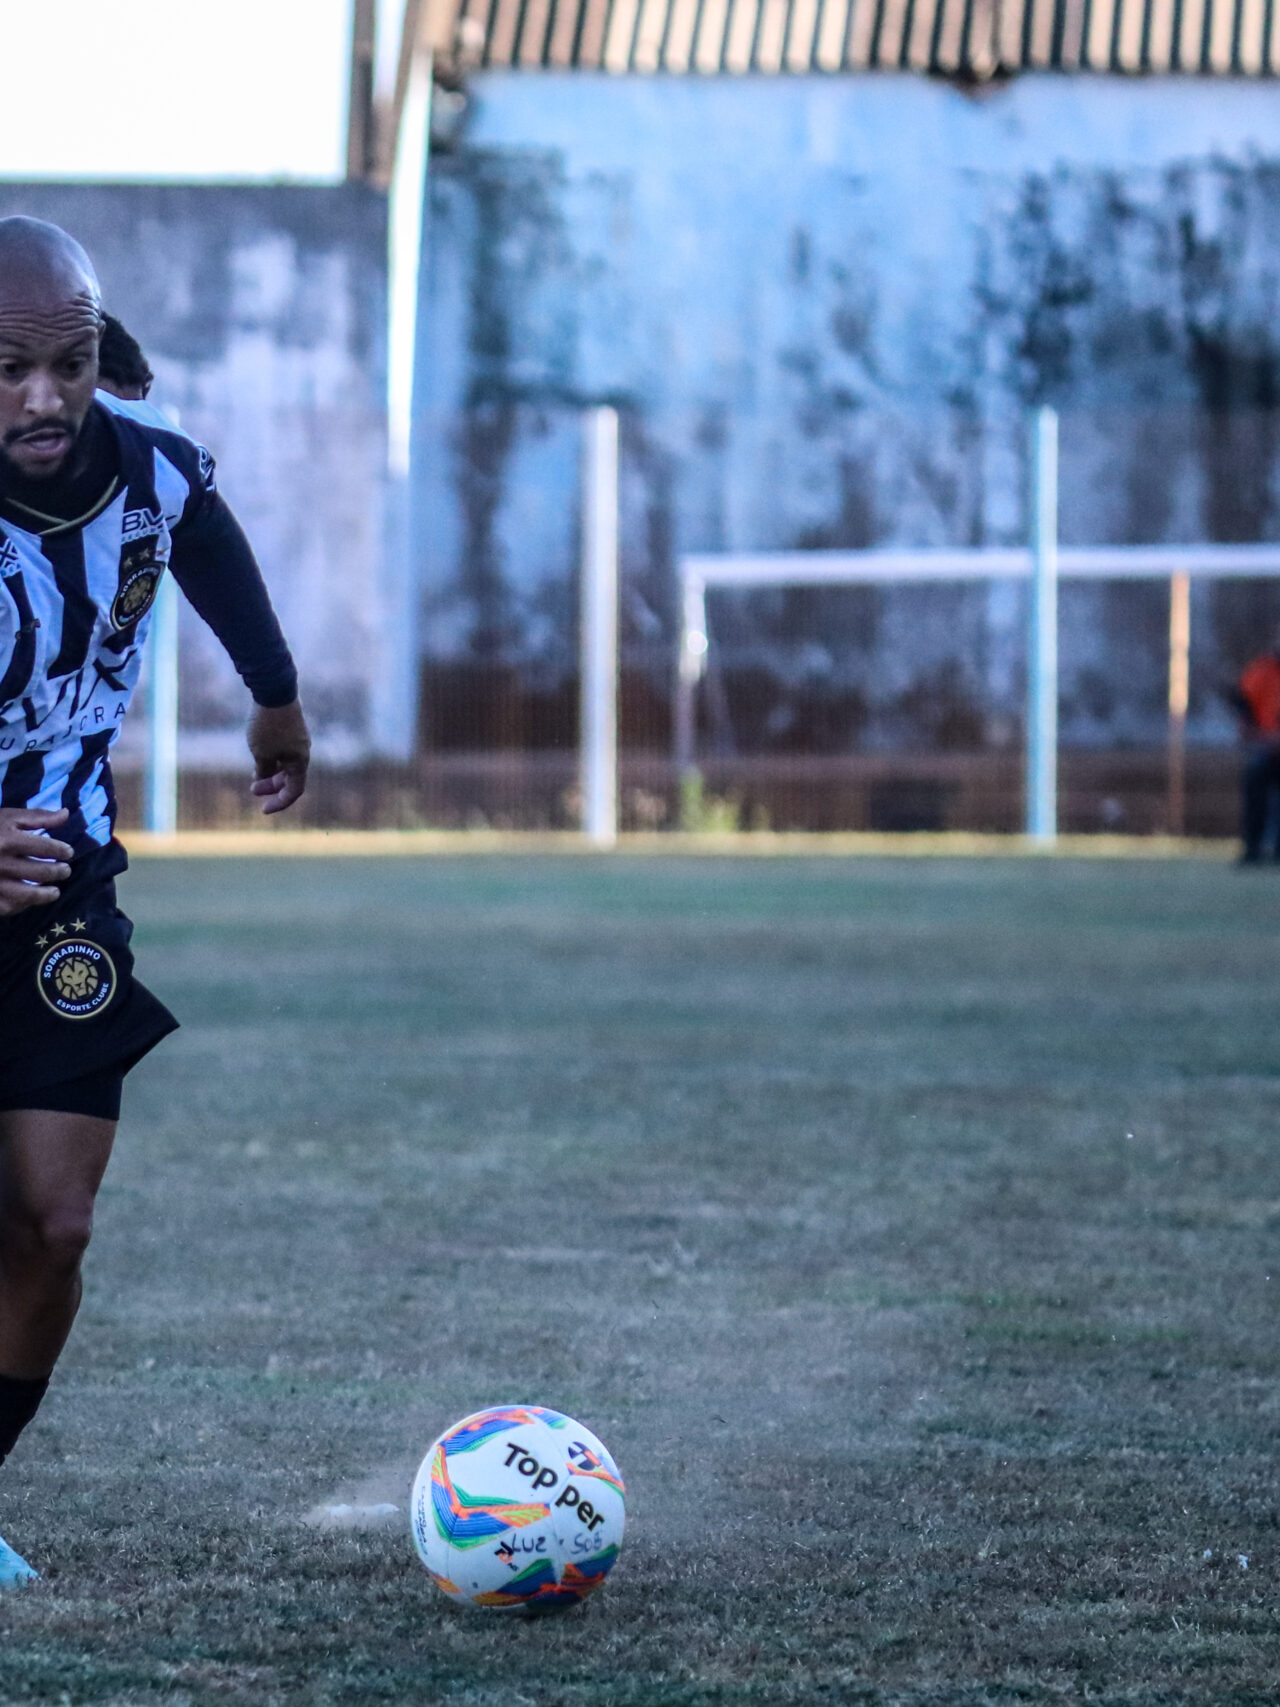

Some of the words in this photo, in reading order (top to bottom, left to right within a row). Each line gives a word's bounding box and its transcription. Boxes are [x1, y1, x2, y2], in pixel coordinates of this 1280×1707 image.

[43, 945, 101, 978] SOBRADINHO
[56, 998, 92, 1012] ESPORTE
[91, 983, 110, 1006] CLUBE
